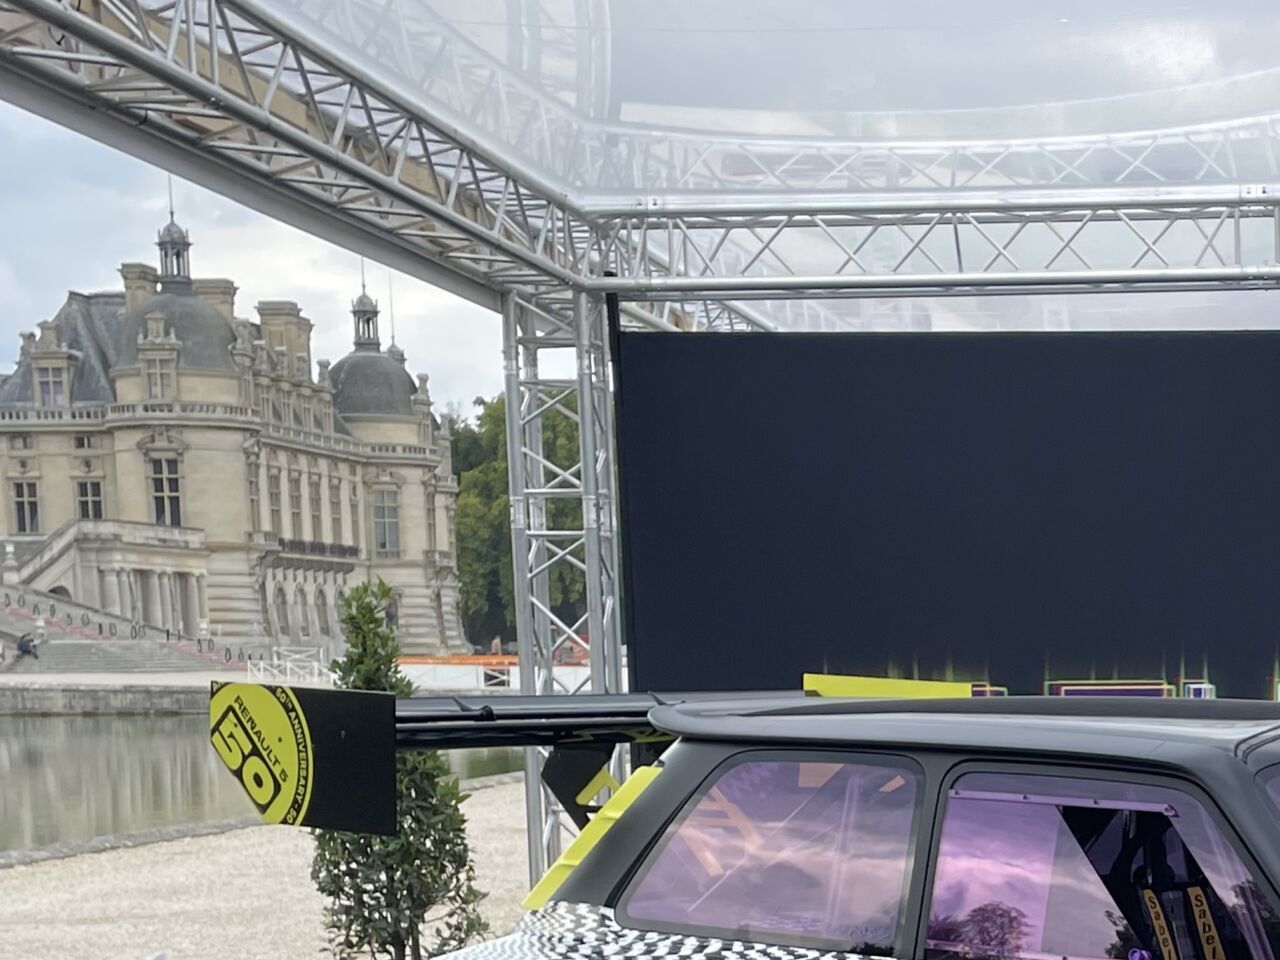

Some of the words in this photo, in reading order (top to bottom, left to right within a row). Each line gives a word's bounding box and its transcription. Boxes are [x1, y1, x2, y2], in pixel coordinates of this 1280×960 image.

[210, 710, 276, 806] 50
[233, 694, 281, 768] RENAULT
[288, 710, 308, 804] ANNIVERSARY
